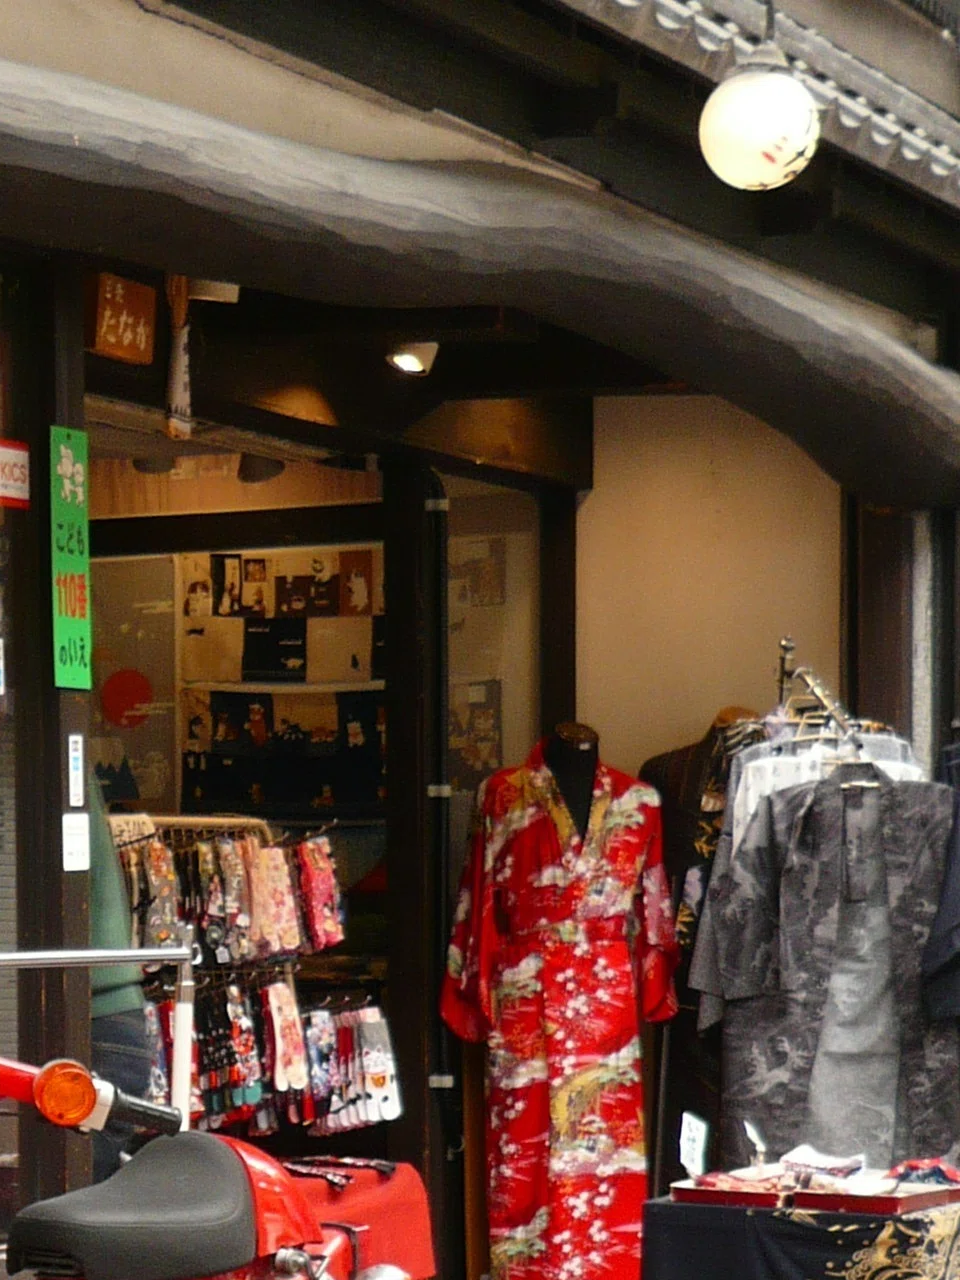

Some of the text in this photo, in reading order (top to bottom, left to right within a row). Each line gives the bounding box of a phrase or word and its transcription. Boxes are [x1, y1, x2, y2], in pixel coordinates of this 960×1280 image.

[55, 522, 85, 556] こども
[55, 572, 87, 620] 110番
[59, 636, 88, 669] のいえ
